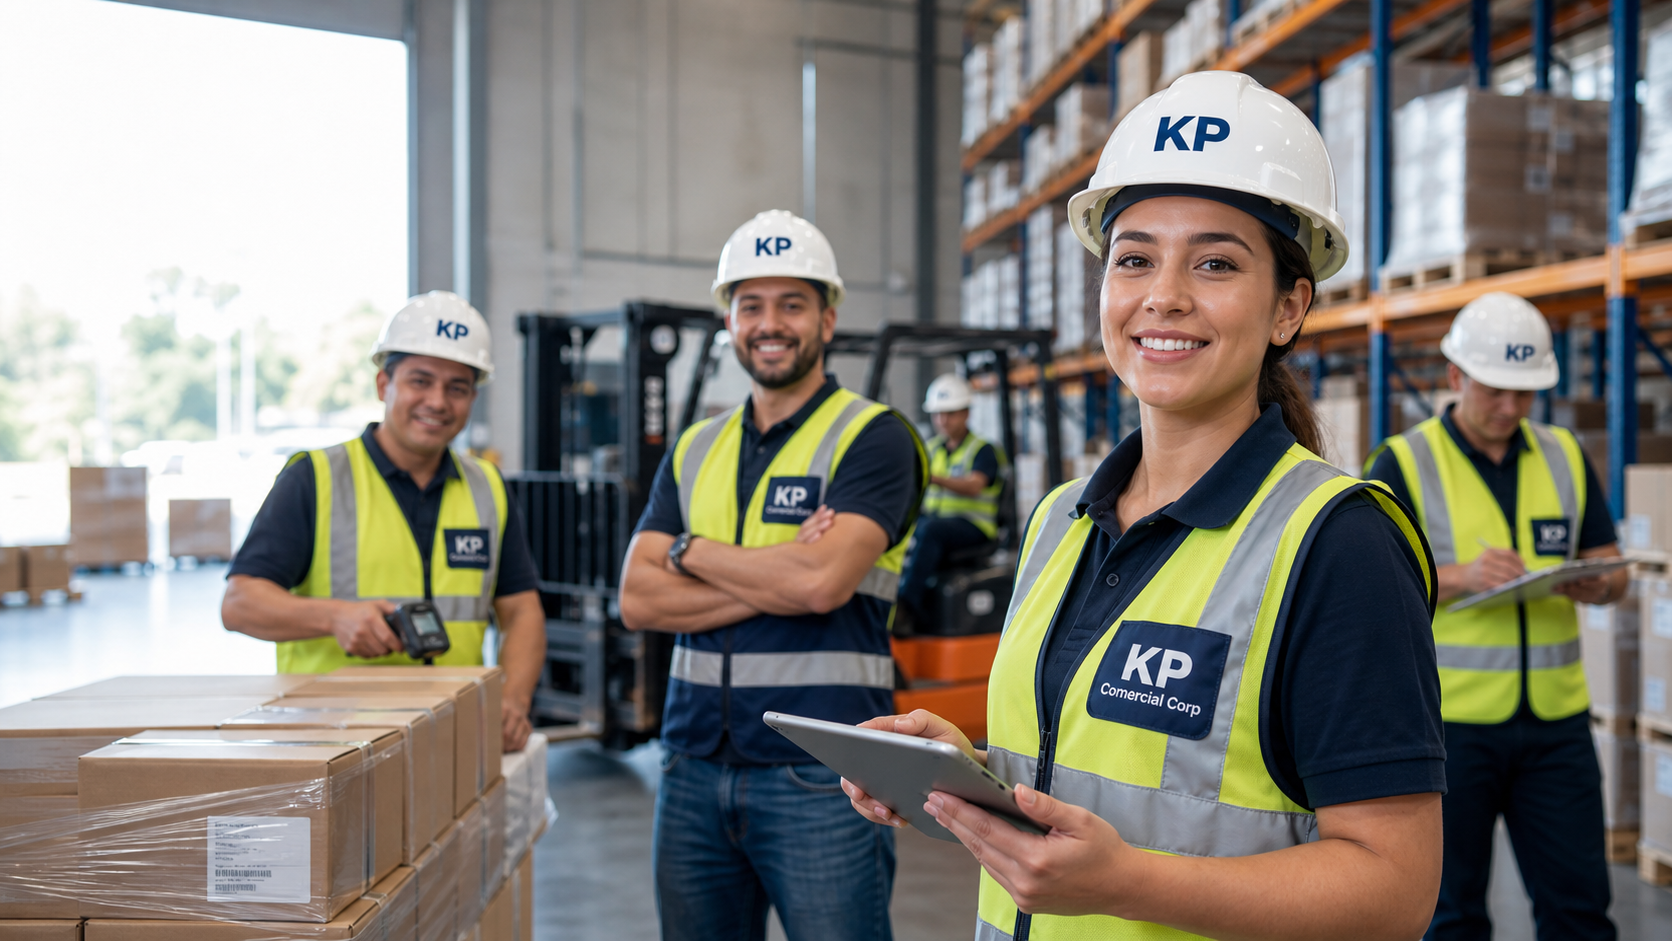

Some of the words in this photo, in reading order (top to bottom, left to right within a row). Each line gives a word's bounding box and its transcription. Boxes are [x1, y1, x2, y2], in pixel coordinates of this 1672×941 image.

[1153, 115, 1231, 152] KP
[755, 236, 792, 257] KP
[436, 319, 469, 340] KP
[1505, 343, 1535, 362] KP
[773, 485, 808, 507] KP
[455, 535, 484, 554] KP
[1120, 643, 1193, 689] KP
[1100, 682, 1165, 708] Comercial
[1166, 696, 1202, 718] Corp
